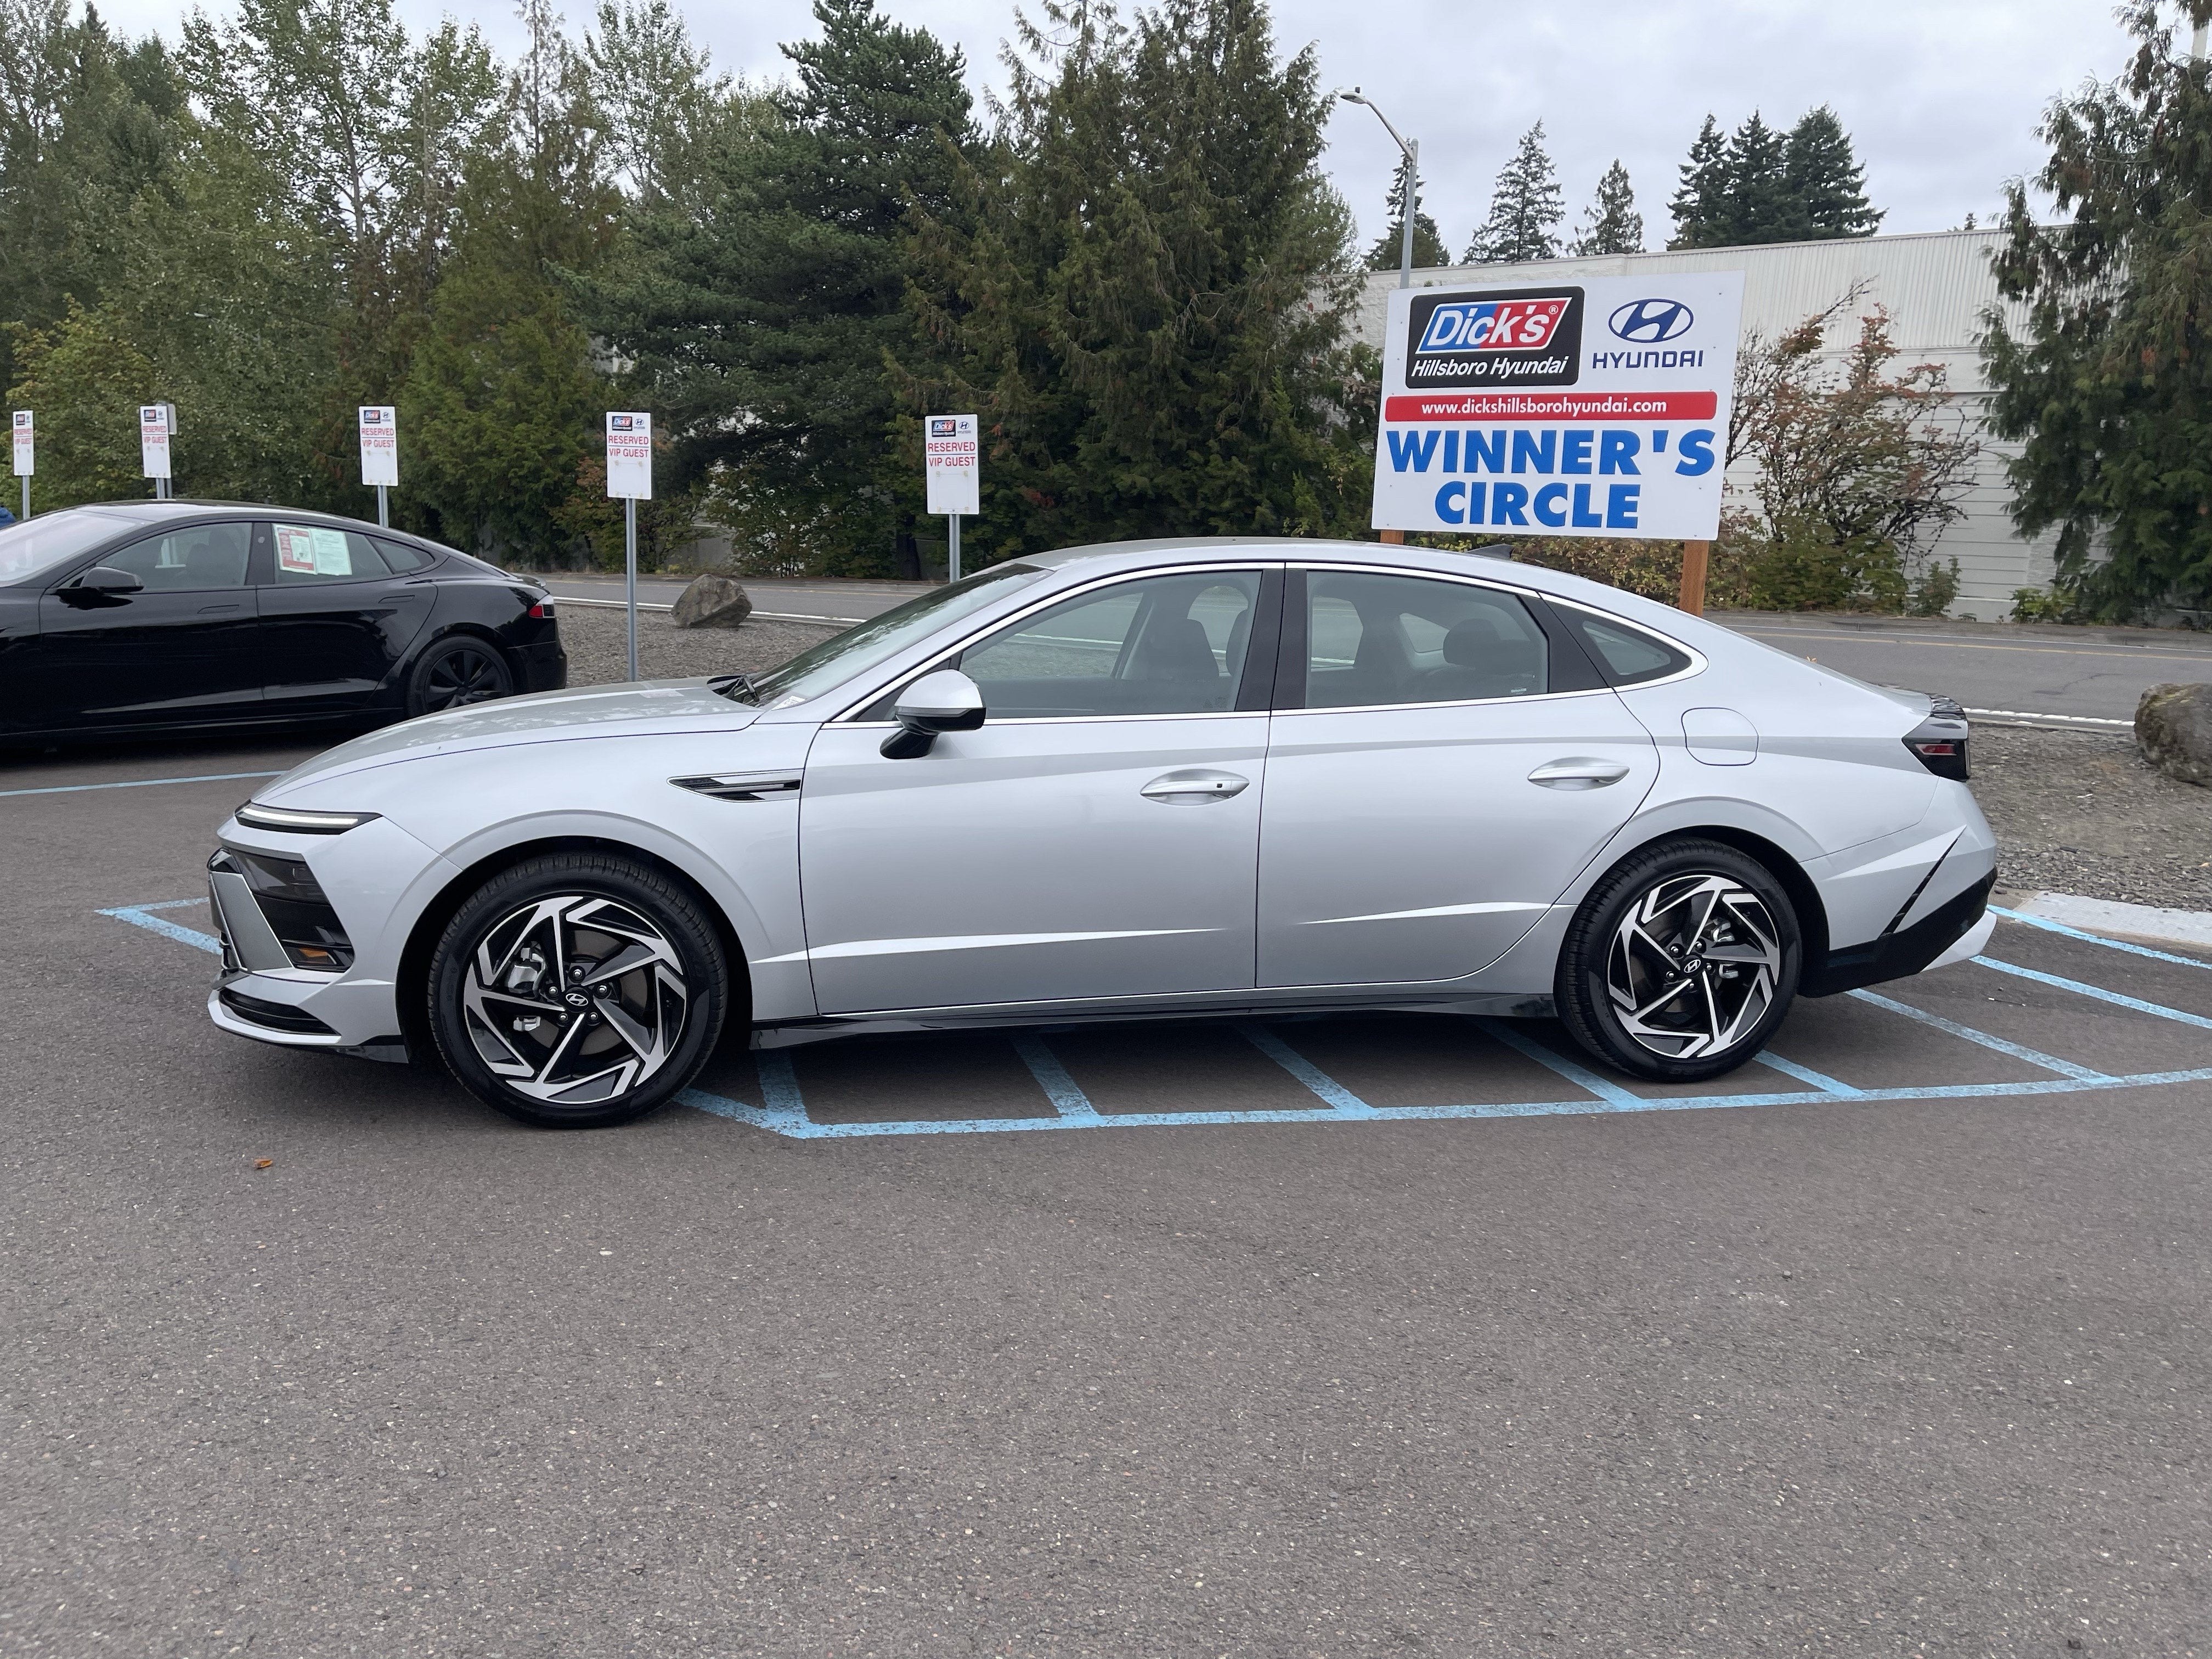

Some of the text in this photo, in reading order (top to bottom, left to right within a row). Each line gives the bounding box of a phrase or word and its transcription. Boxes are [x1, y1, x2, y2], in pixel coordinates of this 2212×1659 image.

[1426, 304, 1550, 346] Dick's
[1592, 350, 1704, 369] HYUNDAI
[1411, 356, 1570, 379] Hillsboro Hyundai
[1421, 396, 1667, 417] www.dickshillsborohyundai.com
[361, 428, 394, 436] RESERVED
[374, 439, 394, 448] GUEST
[608, 435, 649, 445] RESERVED
[928, 442, 975, 452] RESERVED
[609, 448, 648, 458] VIP GUEST
[1386, 429, 1716, 476] WINNER'S
[929, 456, 975, 467] VIP GUEST
[1435, 481, 1641, 528] CIRCLE
